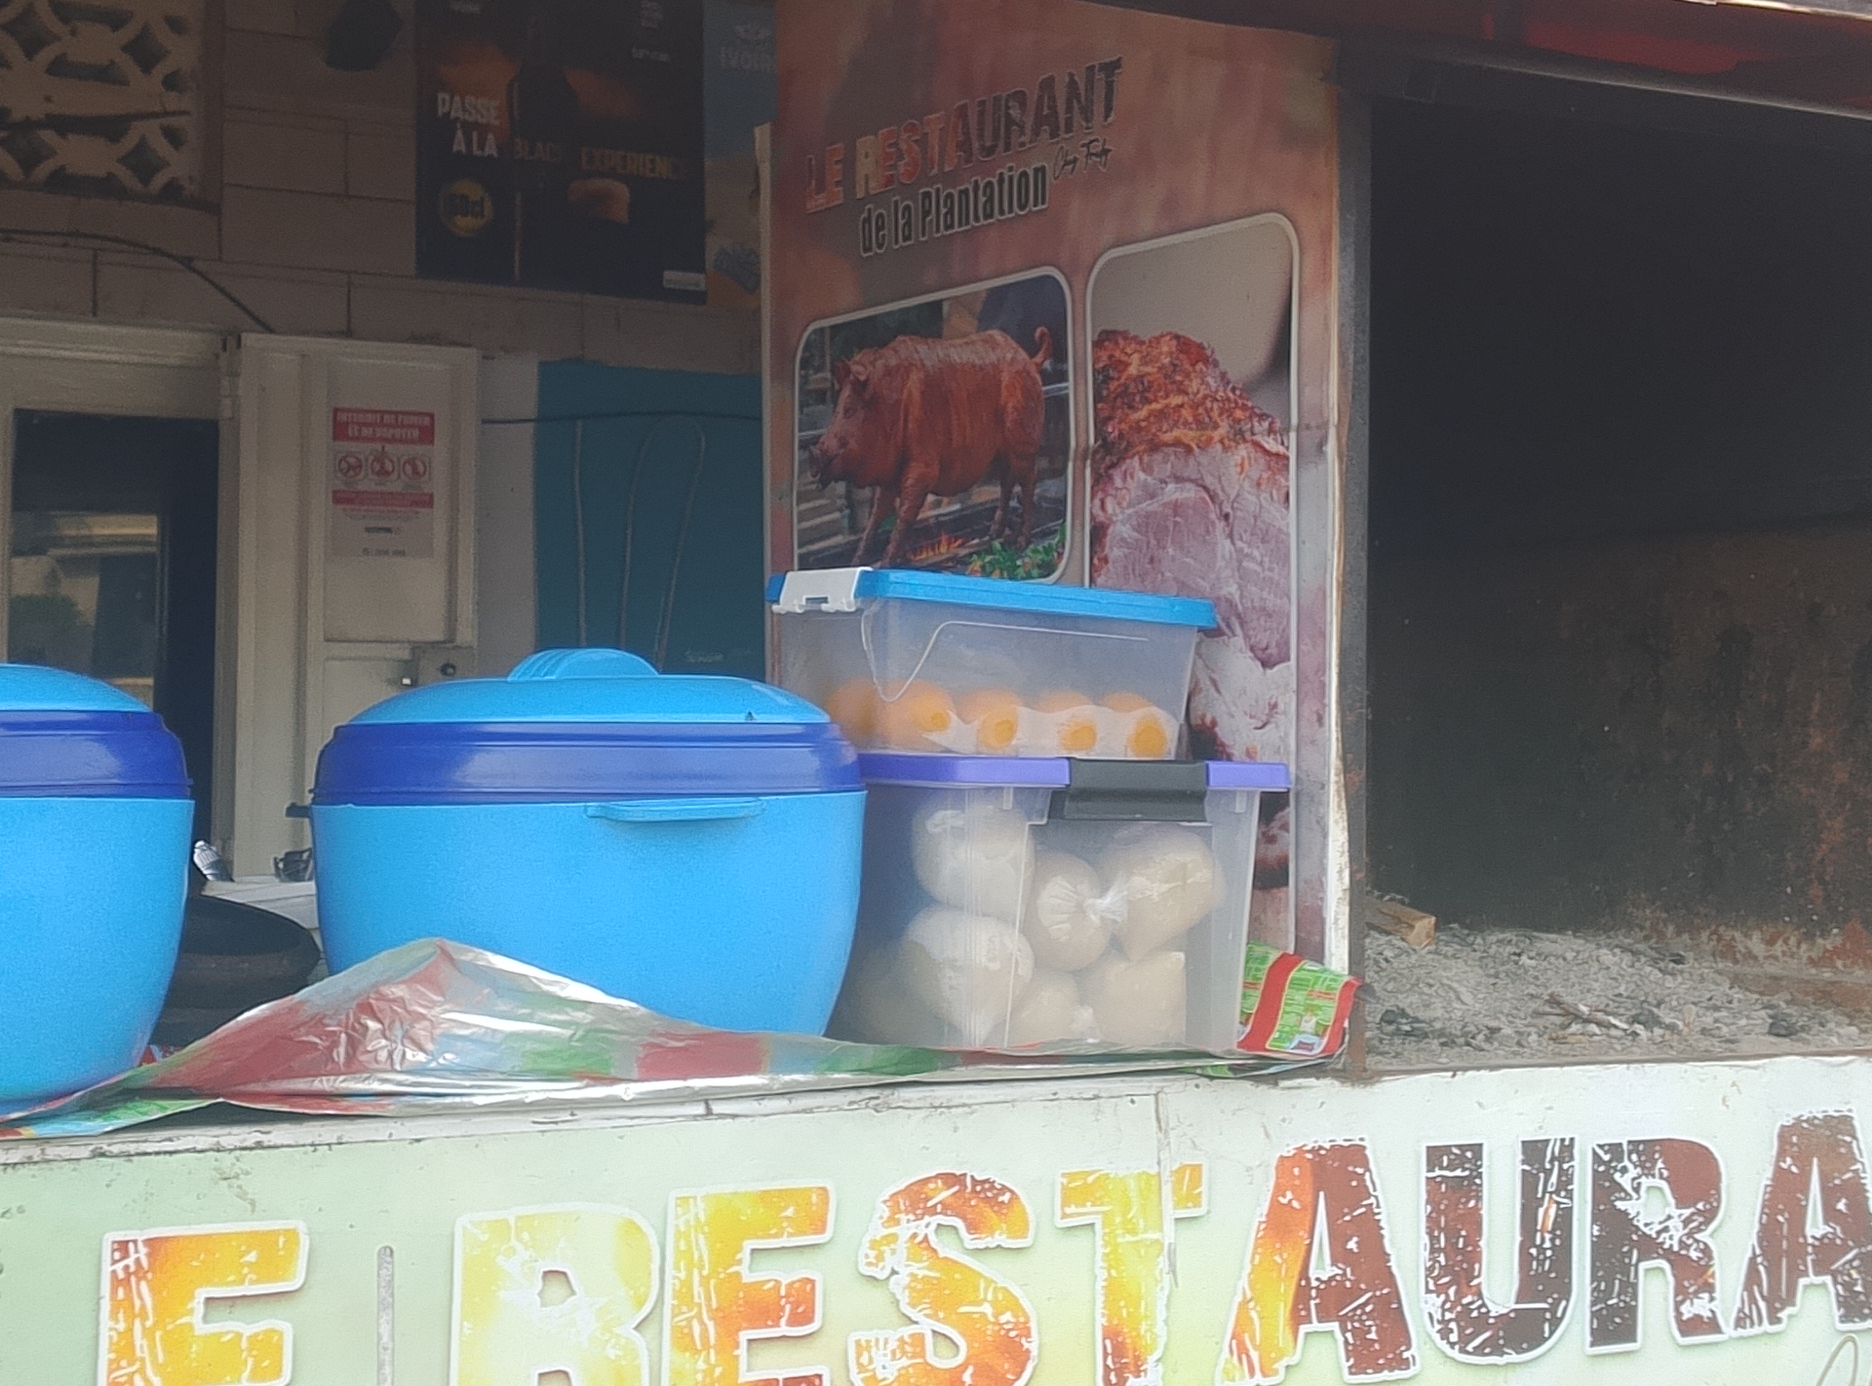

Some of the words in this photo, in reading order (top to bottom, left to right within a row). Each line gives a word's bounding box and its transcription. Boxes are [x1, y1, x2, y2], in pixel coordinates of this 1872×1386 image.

[436, 92, 501, 126] PASSE
[452, 121, 467, 154] À
[472, 129, 499, 159] LA
[512, 137, 568, 164] BLAC
[805, 142, 844, 213] LE
[855, 56, 1123, 200] RESTAURANT
[859, 204, 887, 257] de
[893, 194, 915, 250] la
[917, 161, 1049, 243] Plantation
